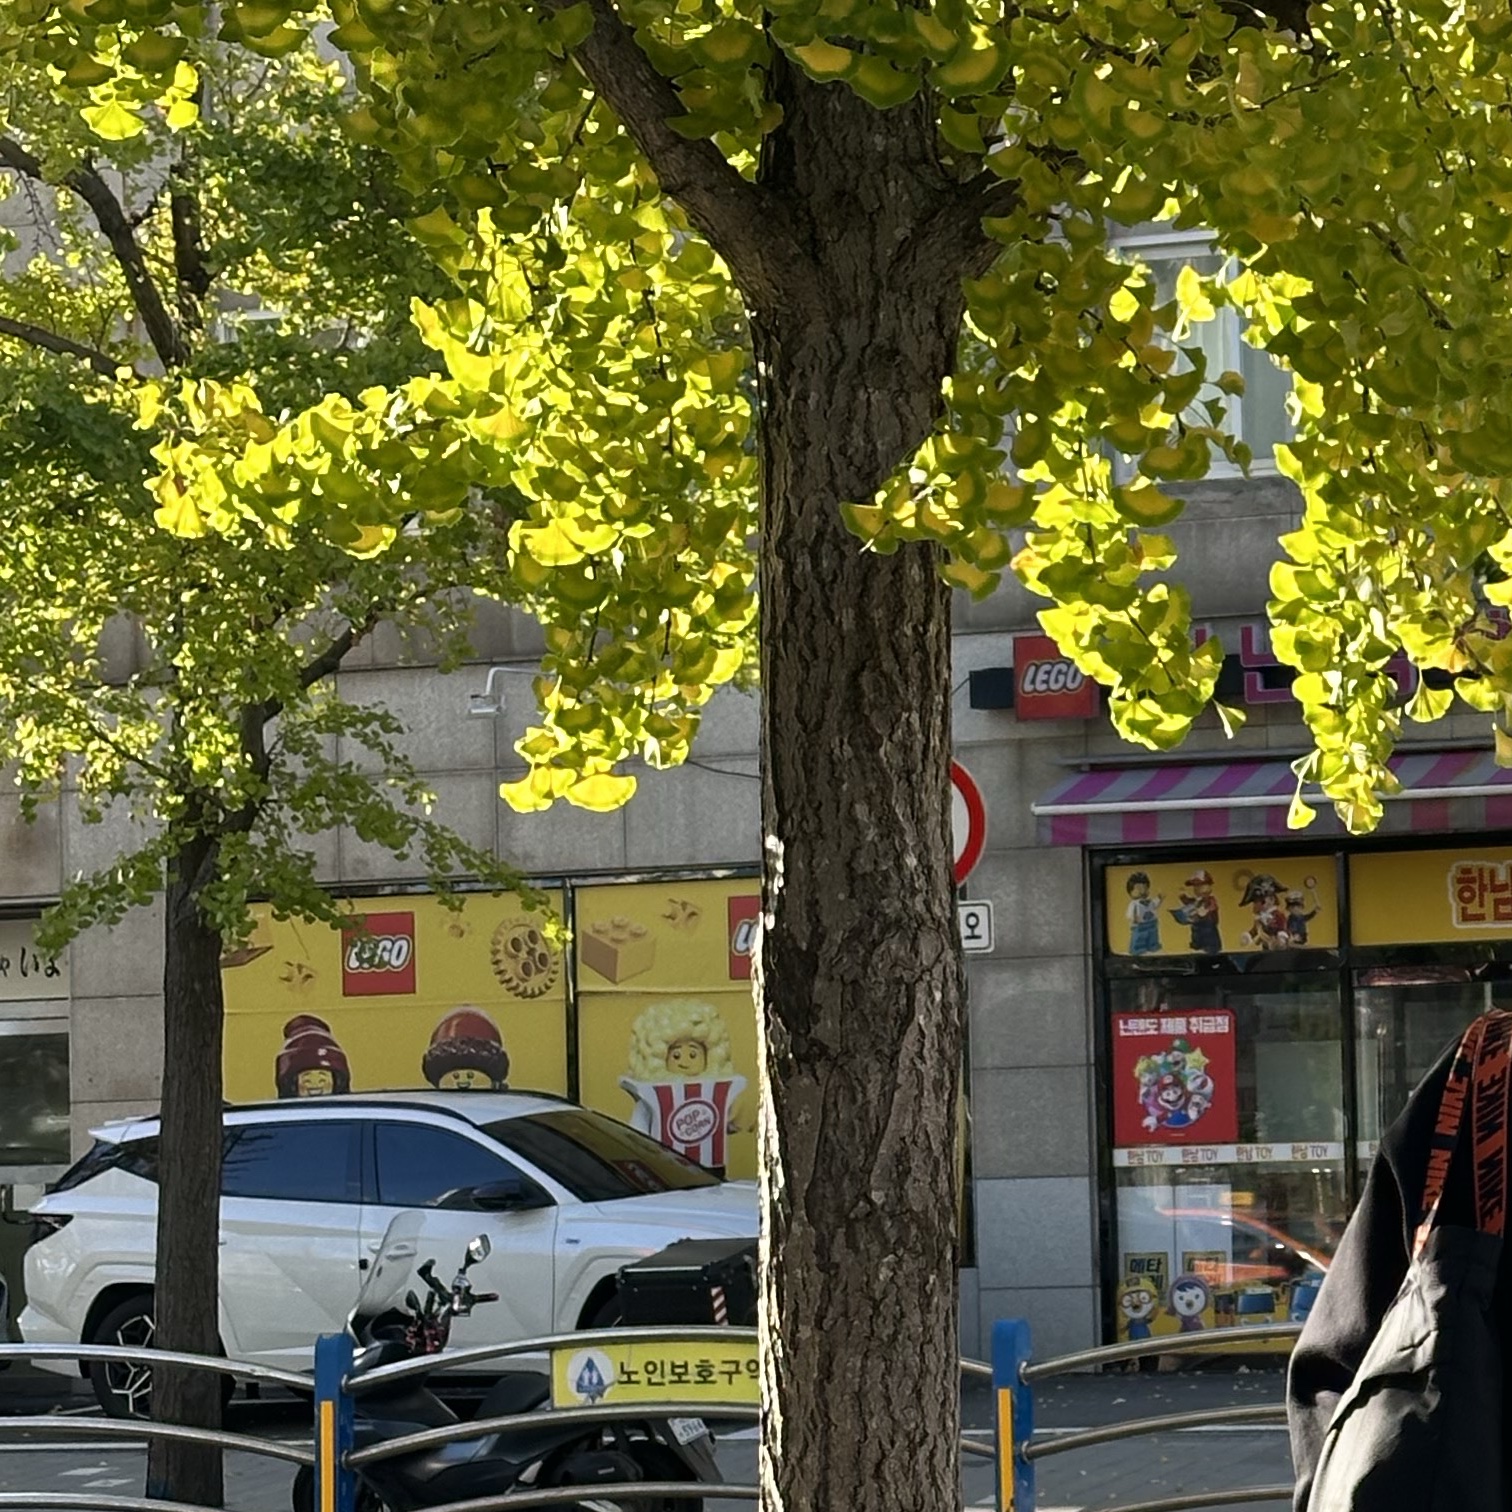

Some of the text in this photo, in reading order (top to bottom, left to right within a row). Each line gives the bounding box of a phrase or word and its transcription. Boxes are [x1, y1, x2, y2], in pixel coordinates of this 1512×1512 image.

[1022, 662, 1084, 694] LEGO
[1475, 1065, 1507, 1141] NIKE
[1146, 1149, 1165, 1163] TOY
[1200, 1147, 1218, 1161] TOY
[1309, 1144, 1329, 1158] TOY
[1476, 1145, 1504, 1220] NIKE
